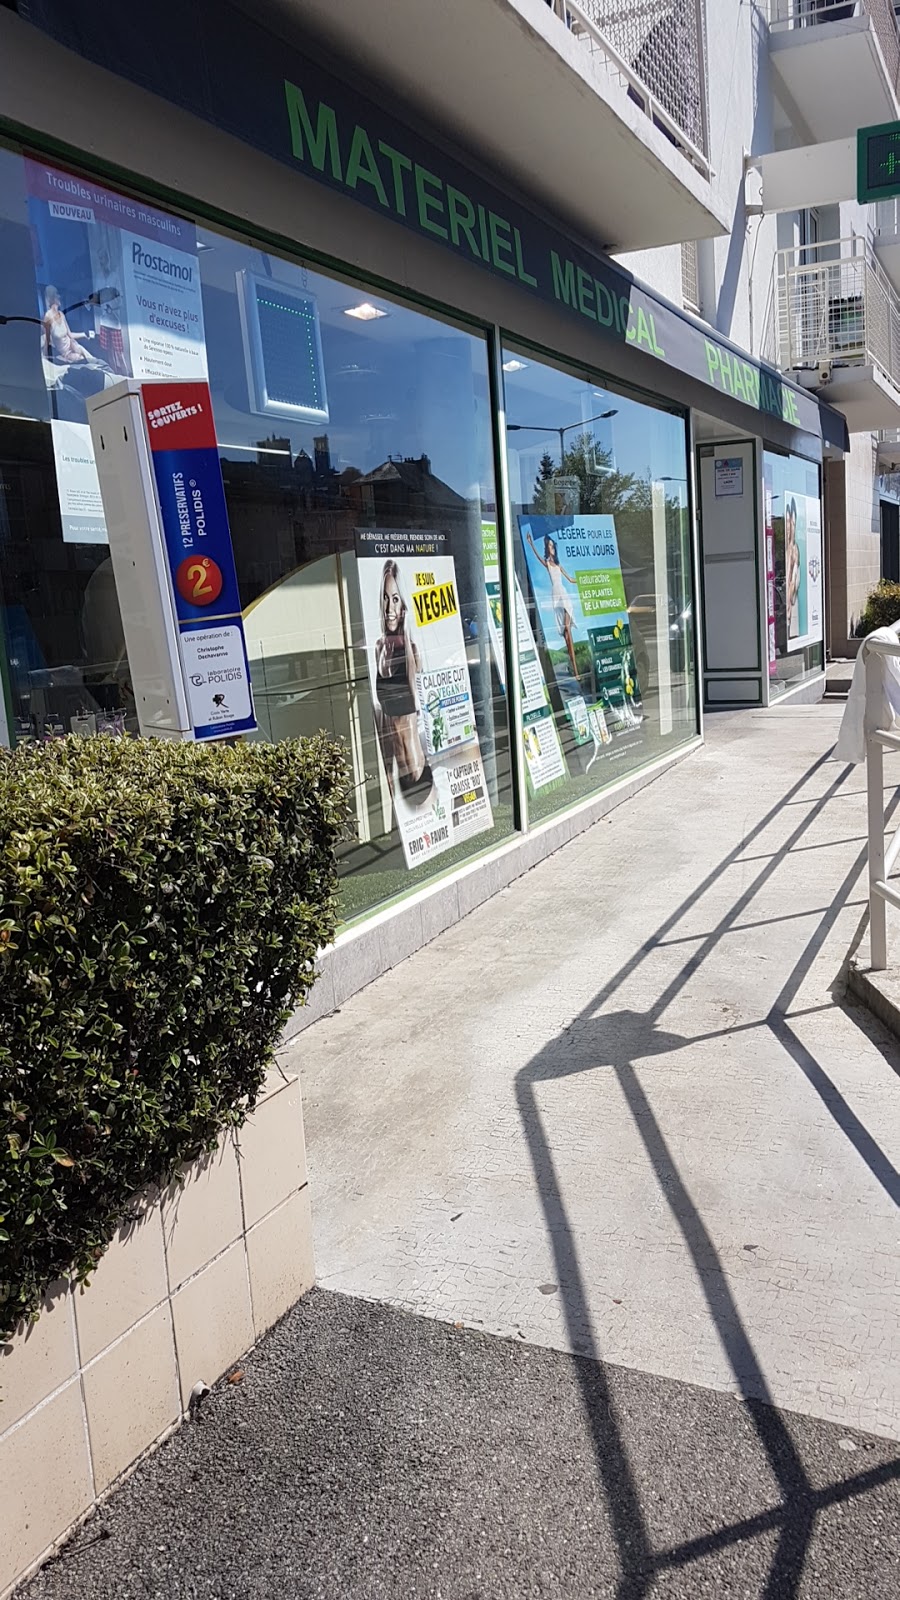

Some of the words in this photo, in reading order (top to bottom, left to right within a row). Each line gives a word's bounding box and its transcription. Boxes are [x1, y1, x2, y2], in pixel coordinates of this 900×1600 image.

[46, 172, 91, 200] Troubles
[94, 192, 136, 218] urinaires
[138, 211, 181, 236] masculins
[52, 204, 92, 220] NOUVEAU
[284, 78, 538, 288] MATERIEL
[550, 250, 665, 358] MEDICAL
[132, 241, 193, 283] Prostamol
[136, 295, 157, 310] Vous
[158, 301, 182, 318] n'avez
[183, 309, 199, 323] plus
[149, 314, 186, 333] d'excuses
[704, 339, 801, 425] PHARMACIE
[147, 401, 183, 421] SORTEZ
[150, 406, 197, 429] COUVERTS
[62, 454, 70, 462] Les
[70, 456, 89, 464] troubles
[172, 472, 193, 537] PRESERVATIFS
[191, 489, 207, 536] POLIDIS
[360, 533, 366, 541] ME
[384, 533, 390, 541] ME
[409, 533, 424, 541] PRENDRE
[587, 529, 602, 539] POUR
[603, 529, 613, 539] LES
[183, 537, 193, 549] 12
[374, 543, 389, 554] C'EST
[389, 543, 405, 553] DANS
[405, 543, 415, 553] MA
[415, 543, 435, 553] NATURE
[565, 545, 591, 558] BEAUX
[591, 544, 616, 557] JOURS
[415, 572, 422, 586] JE
[422, 572, 435, 586] SUIS
[579, 573, 611, 585] naturactive
[581, 589, 591, 599] LES
[591, 587, 613, 598] PLANTES
[413, 584, 457, 623] VEGAN
[584, 601, 592, 611] DE
[592, 600, 600, 610] LA
[599, 598, 622, 609] MINCEUR
[196, 632, 222, 642] opération
[590, 633, 596, 647] 1
[196, 645, 224, 654] Christophe
[197, 651, 228, 660] Dechavanne
[207, 666, 241, 676] laboratoire
[596, 659, 602, 674] 2
[208, 671, 242, 685] POLIDIS
[422, 671, 452, 690] CALORIE
[452, 668, 465, 682] CUT
[436, 683, 461, 699] VEGAN
[602, 686, 609, 701] 3
[452, 763, 473, 780] CAPTEUR
[473, 760, 480, 772] DE
[450, 778, 471, 796] GRAISSE
[408, 837, 424, 856] ERIC
[430, 825, 449, 846] FAVRE
